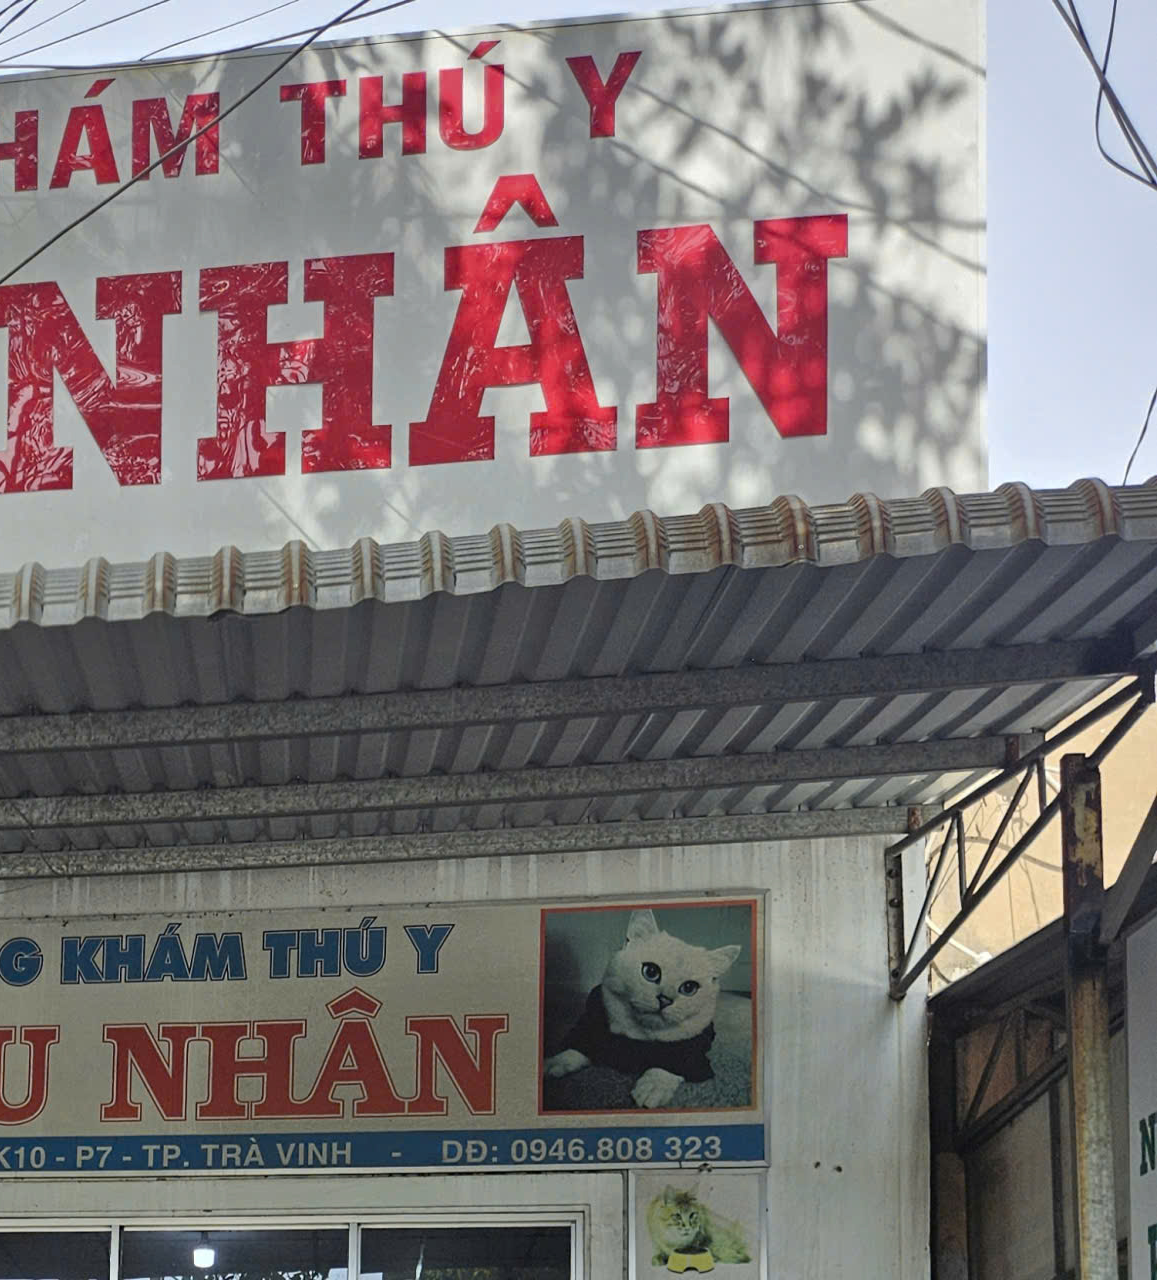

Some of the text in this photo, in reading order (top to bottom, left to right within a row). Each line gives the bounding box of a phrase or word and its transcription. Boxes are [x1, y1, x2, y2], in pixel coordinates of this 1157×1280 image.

[281, 40, 505, 166] THÚ
[566, 51, 642, 139] Y
[60, 922, 247, 984] KHÁM
[262, 917, 388, 981] THÚ
[404, 923, 456, 975] Y
[100, 986, 509, 1121] NHÂN
[77, 1146, 113, 1168] P7
[142, 1145, 190, 1167] TP.
[201, 1137, 266, 1167] TRÀ
[276, 1142, 352, 1166] VINH
[511, 1138, 653, 1162] 0946.808
[665, 1136, 722, 1160] 323
